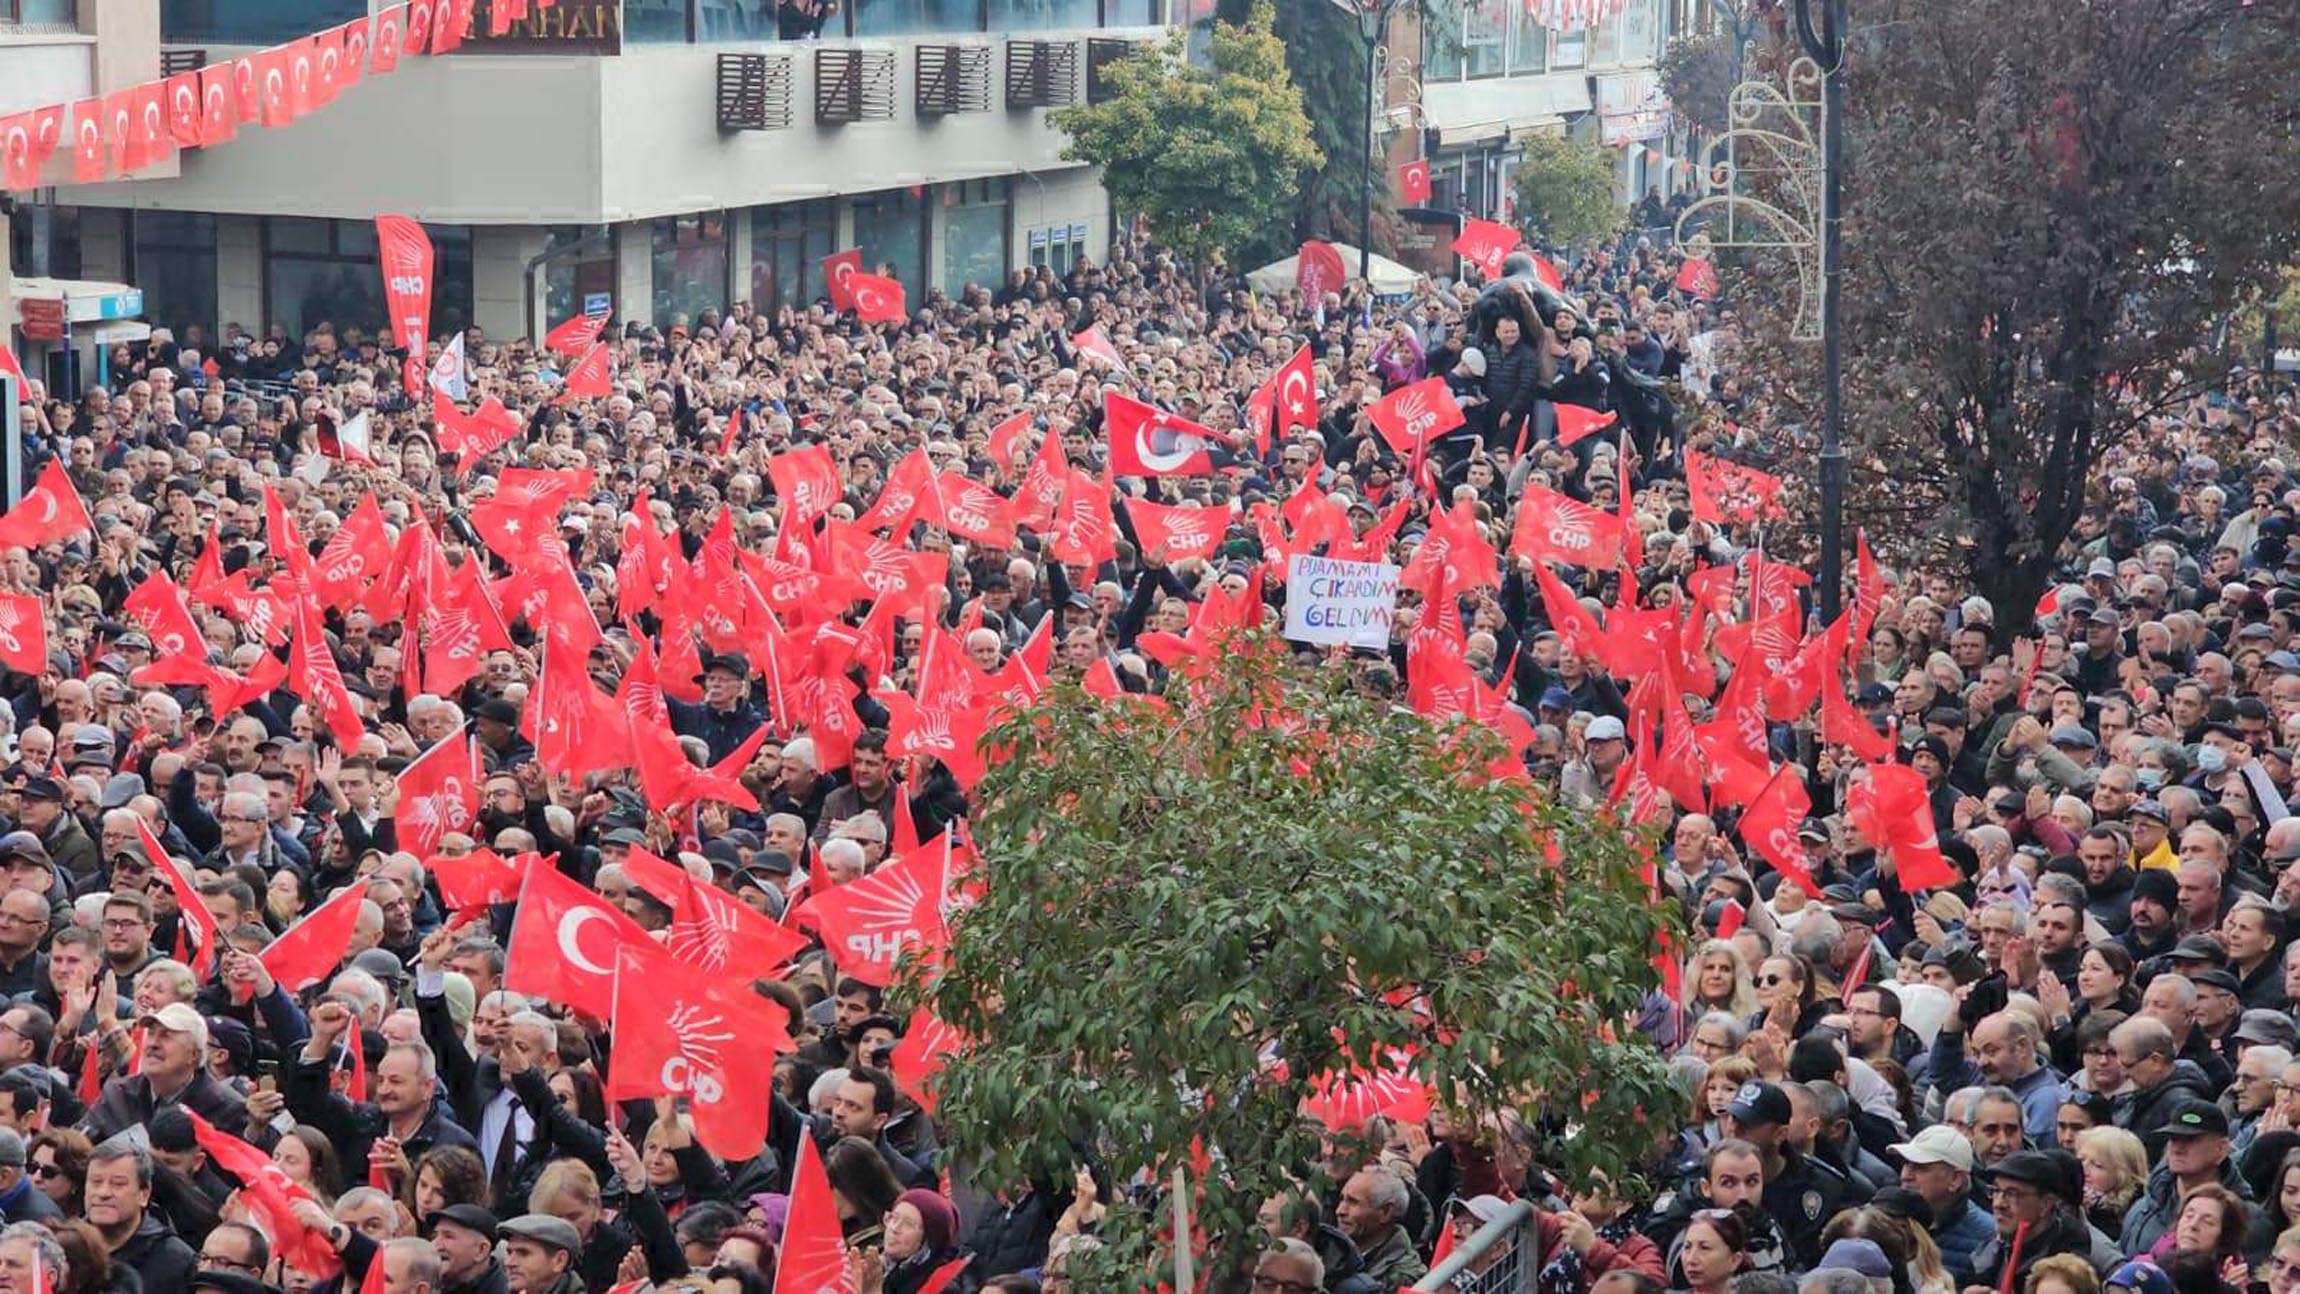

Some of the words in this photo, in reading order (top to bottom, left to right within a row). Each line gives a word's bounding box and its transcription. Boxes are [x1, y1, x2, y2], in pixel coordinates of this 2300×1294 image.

[947, 507, 990, 532] CHP
[1167, 533, 1210, 549] CHP
[1549, 528, 1591, 549] CHP
[772, 574, 821, 601] CHP
[861, 571, 908, 593] CHP
[251, 597, 274, 637] CHP
[1736, 706, 1769, 753] CHP
[661, 1056, 724, 1104] CHP
